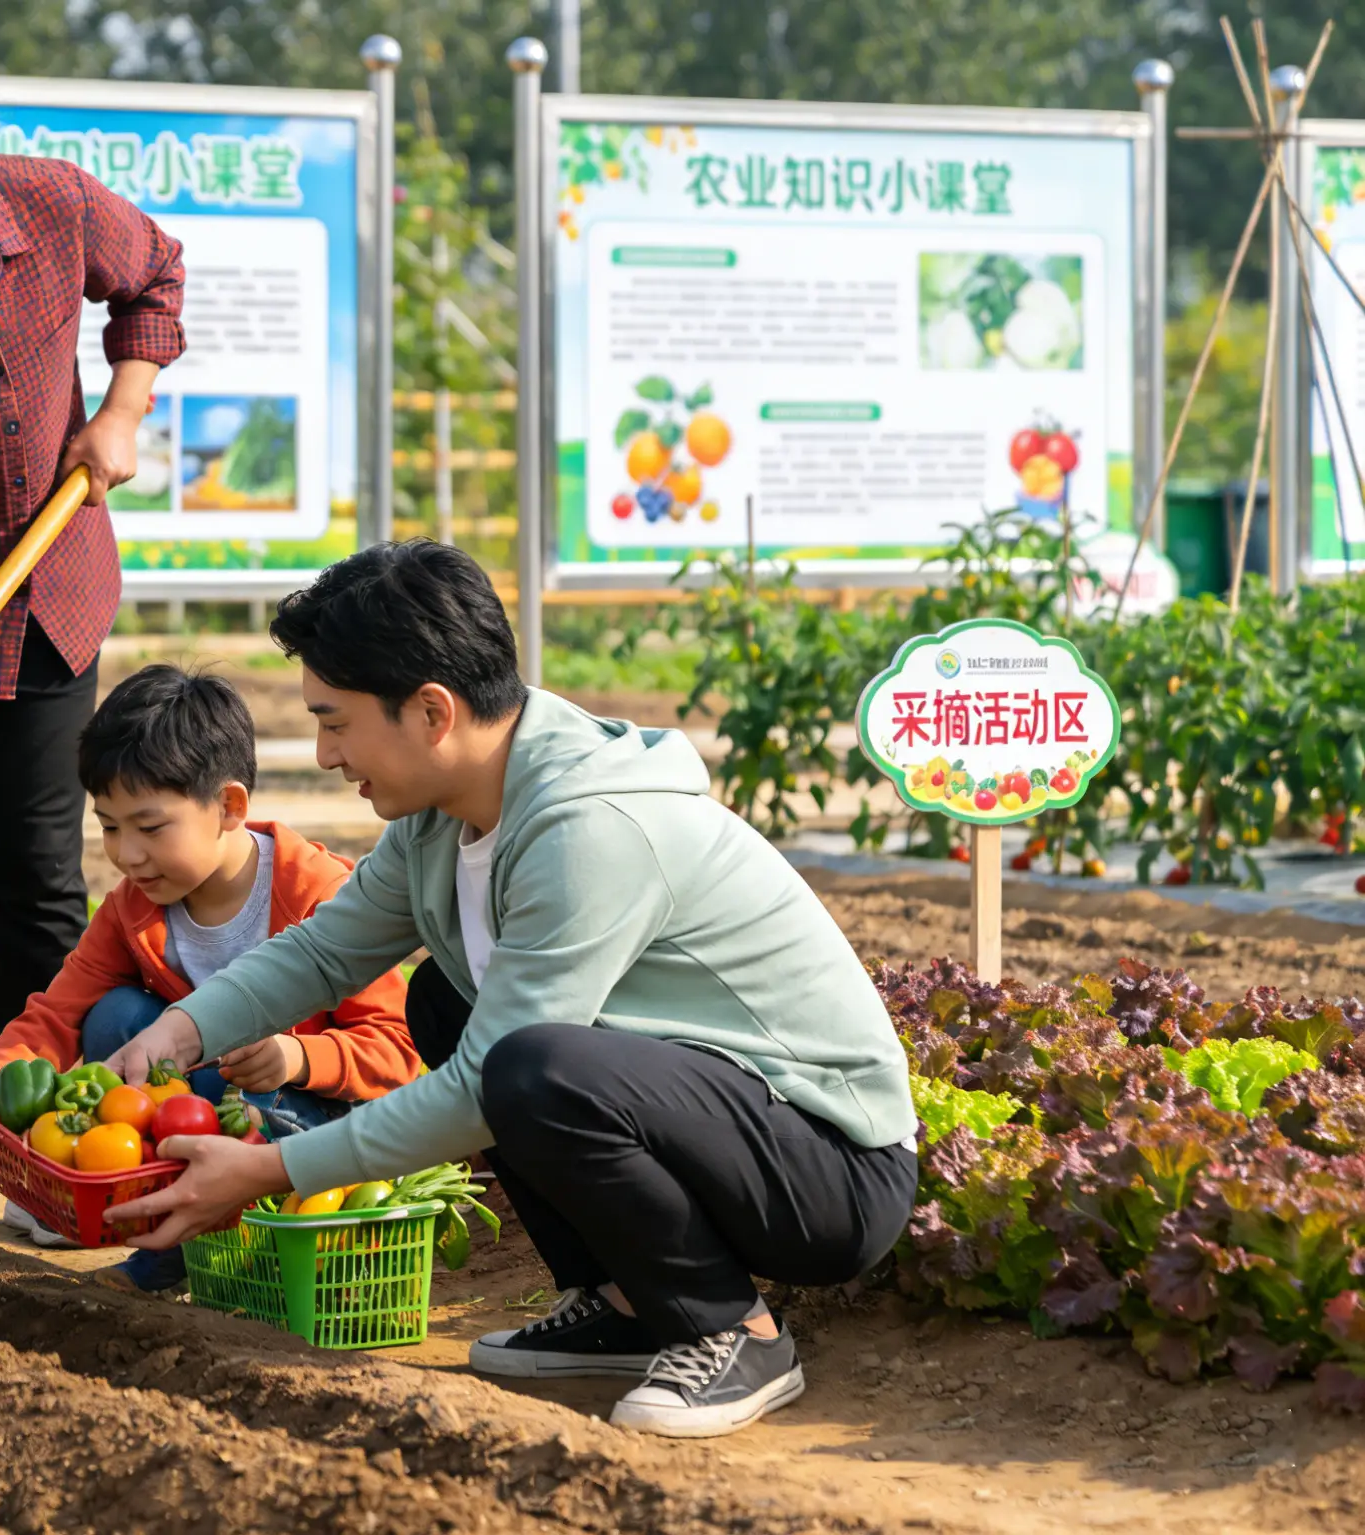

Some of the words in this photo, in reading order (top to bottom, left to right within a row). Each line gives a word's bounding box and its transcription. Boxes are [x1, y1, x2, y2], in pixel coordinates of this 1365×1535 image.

[685, 153, 1012, 215] 农业知识小课堂
[892, 689, 1089, 748] 采摘活动区
